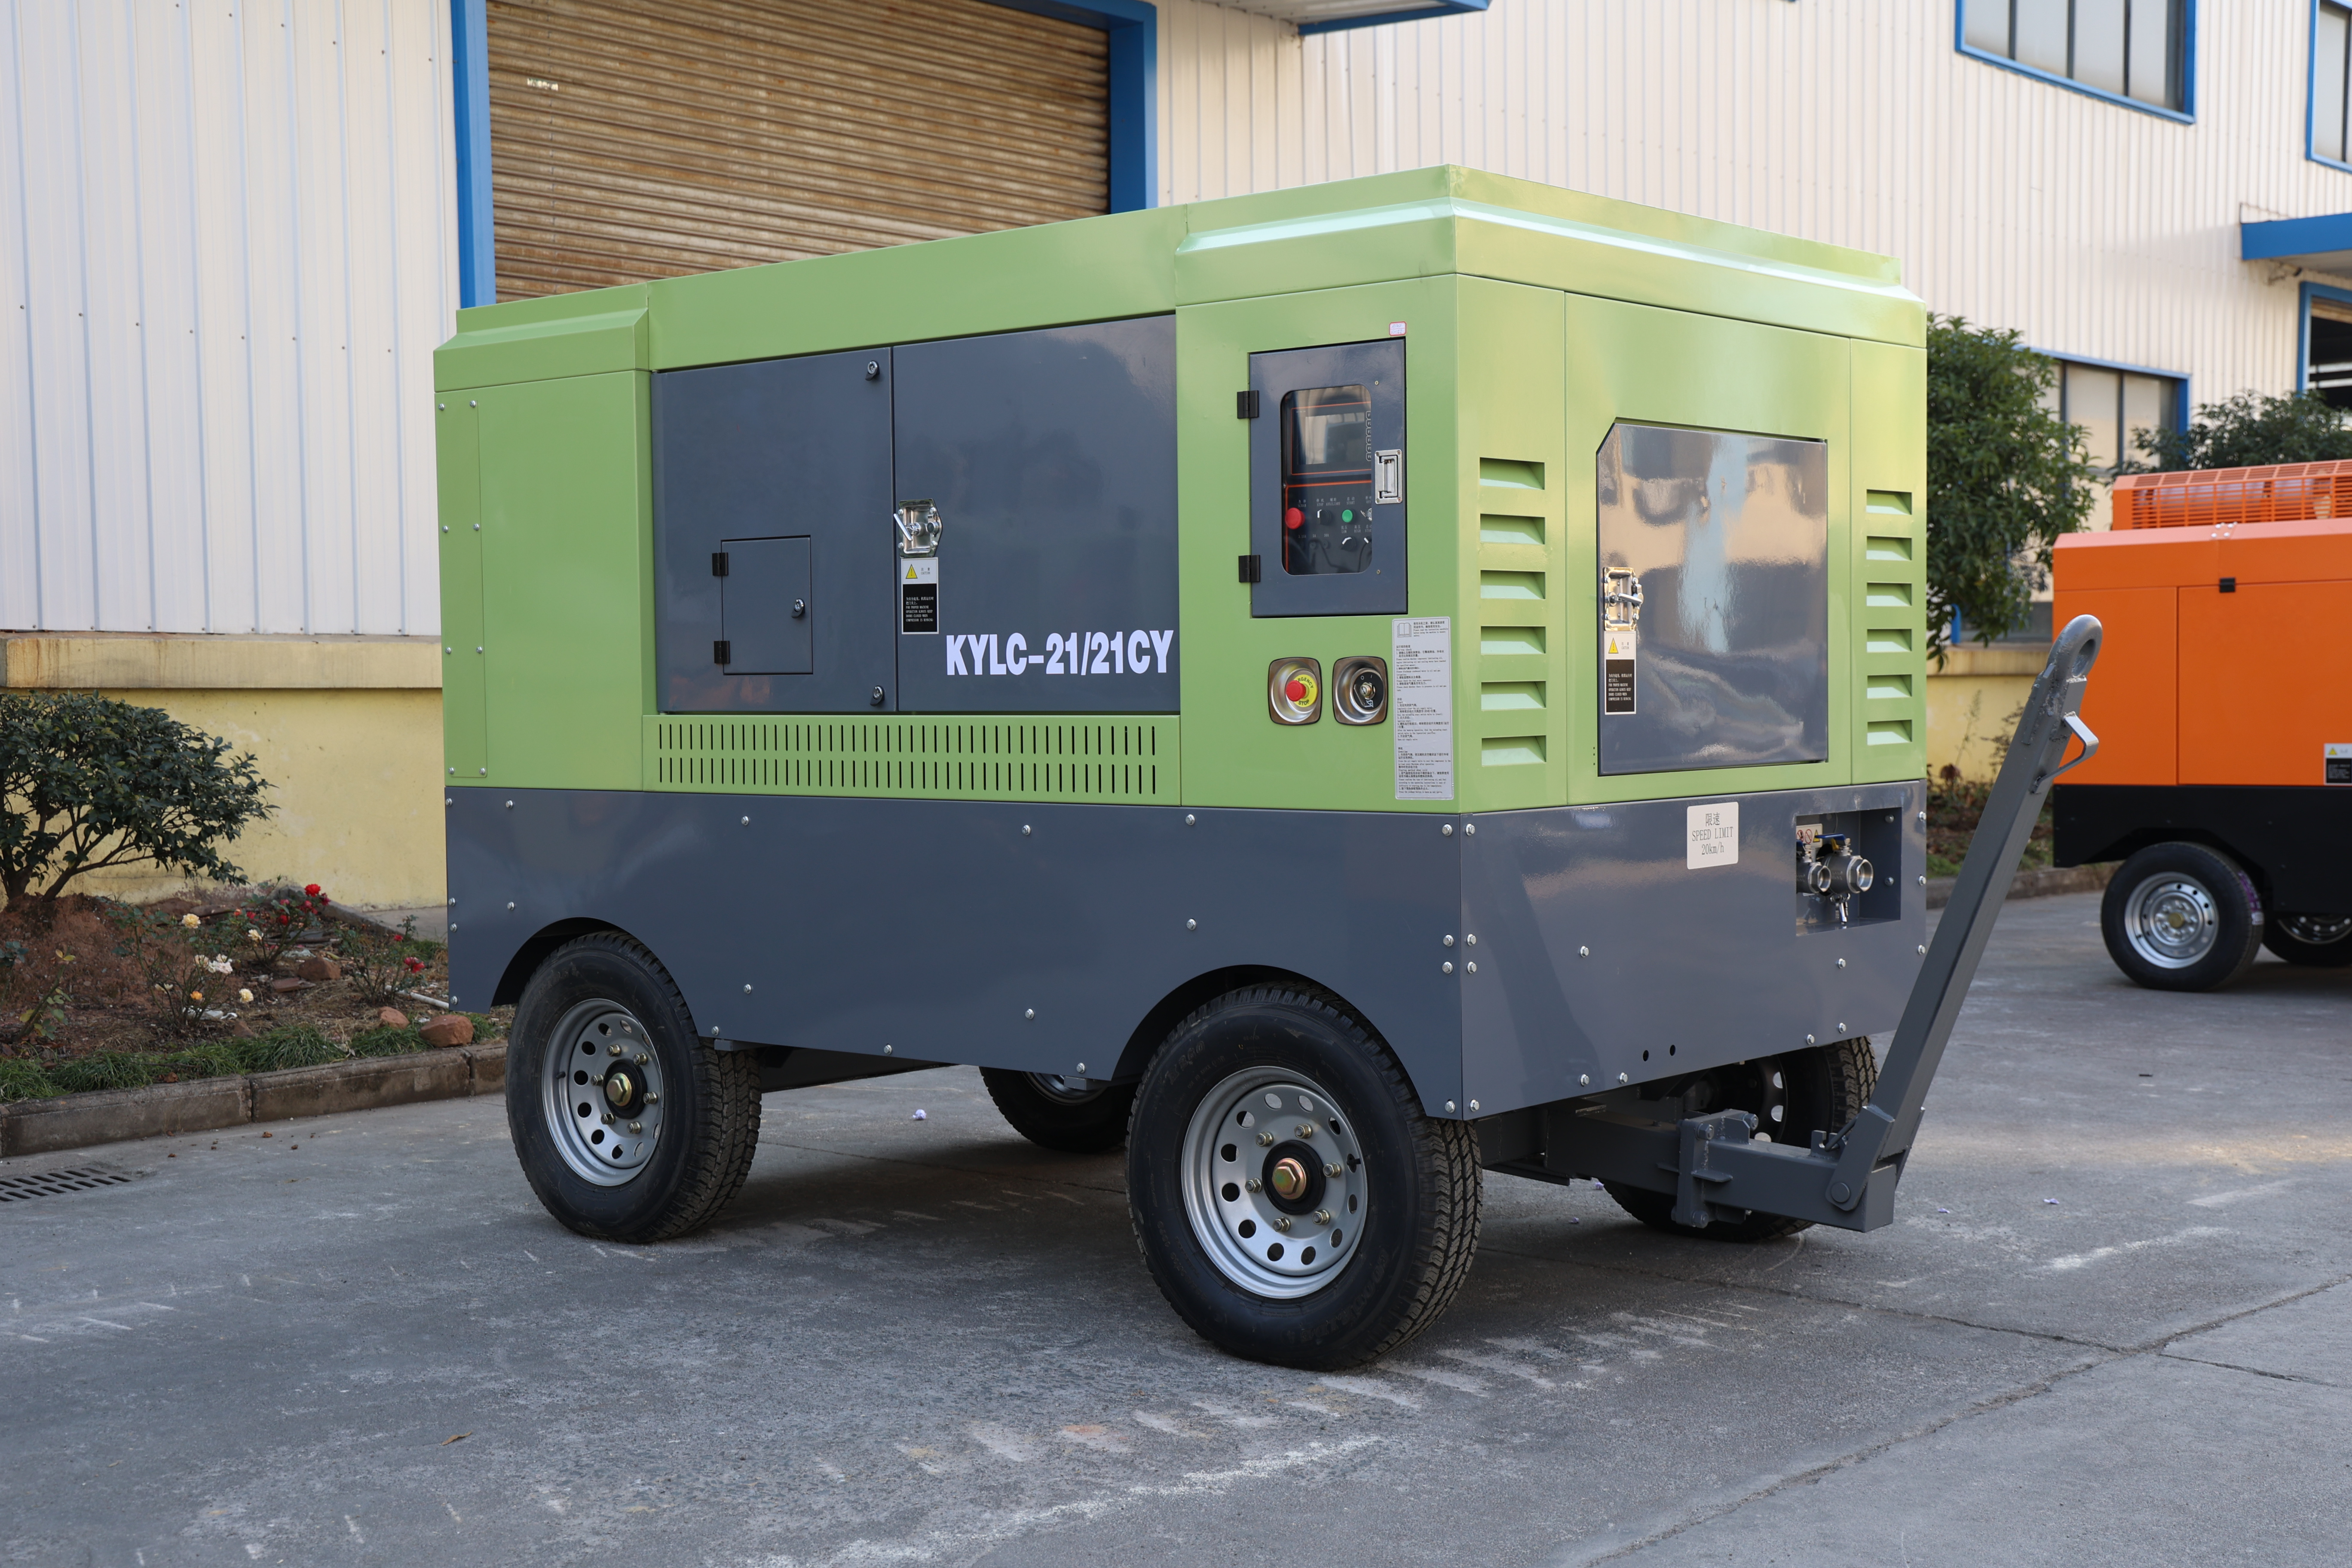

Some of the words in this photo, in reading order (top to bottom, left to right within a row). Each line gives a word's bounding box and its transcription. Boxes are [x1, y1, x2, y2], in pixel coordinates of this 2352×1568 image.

[946, 630, 1174, 676] KYLC-21/21CY
[1298, 677, 1314, 688] RGENCY
[1705, 812, 1720, 827] 限速
[1692, 829, 1711, 841] SPEED
[1715, 827, 1733, 839] LIMIT
[1702, 841, 1724, 855] 20km/h
